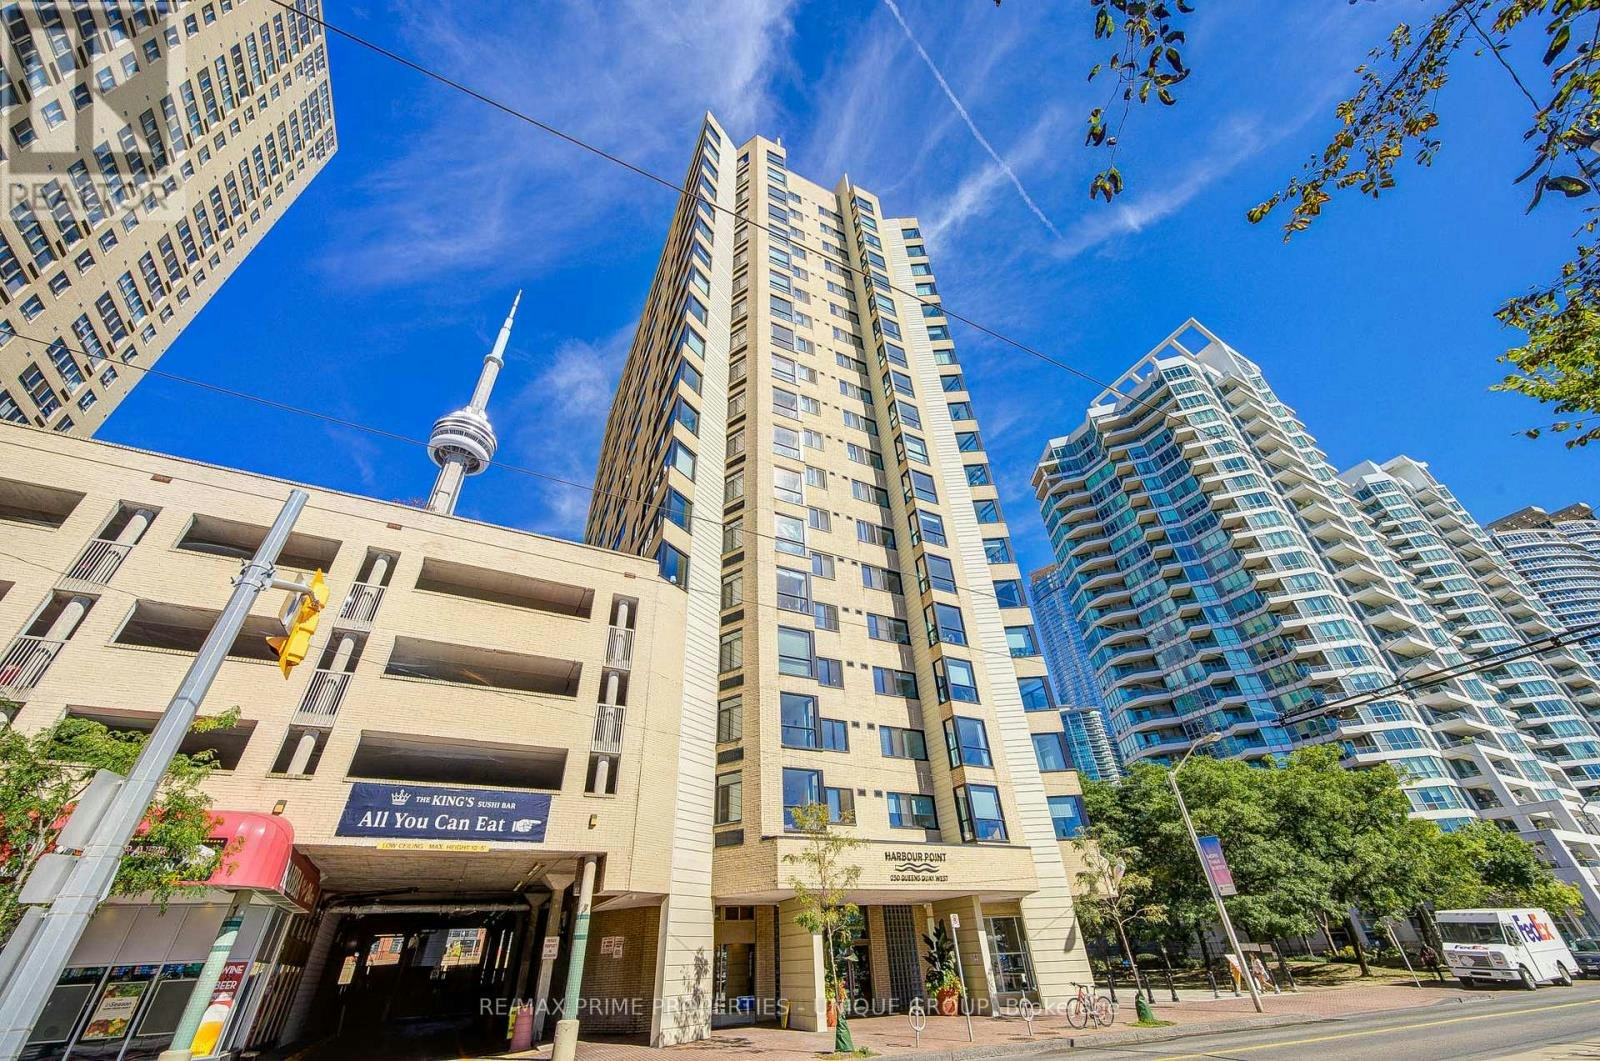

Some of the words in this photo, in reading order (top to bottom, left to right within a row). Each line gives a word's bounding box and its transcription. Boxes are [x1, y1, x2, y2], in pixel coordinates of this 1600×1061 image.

[432, 795, 475, 808] KING'S
[477, 801, 500, 809] SUSHI
[501, 802, 516, 810] BAR
[358, 810, 389, 828] All
[394, 812, 429, 829] You
[434, 814, 470, 831] Can
[475, 816, 505, 832] Eat
[884, 851, 923, 862] HARBOUR
[924, 853, 947, 863] POINT
[1511, 913, 1556, 943] FedEx
